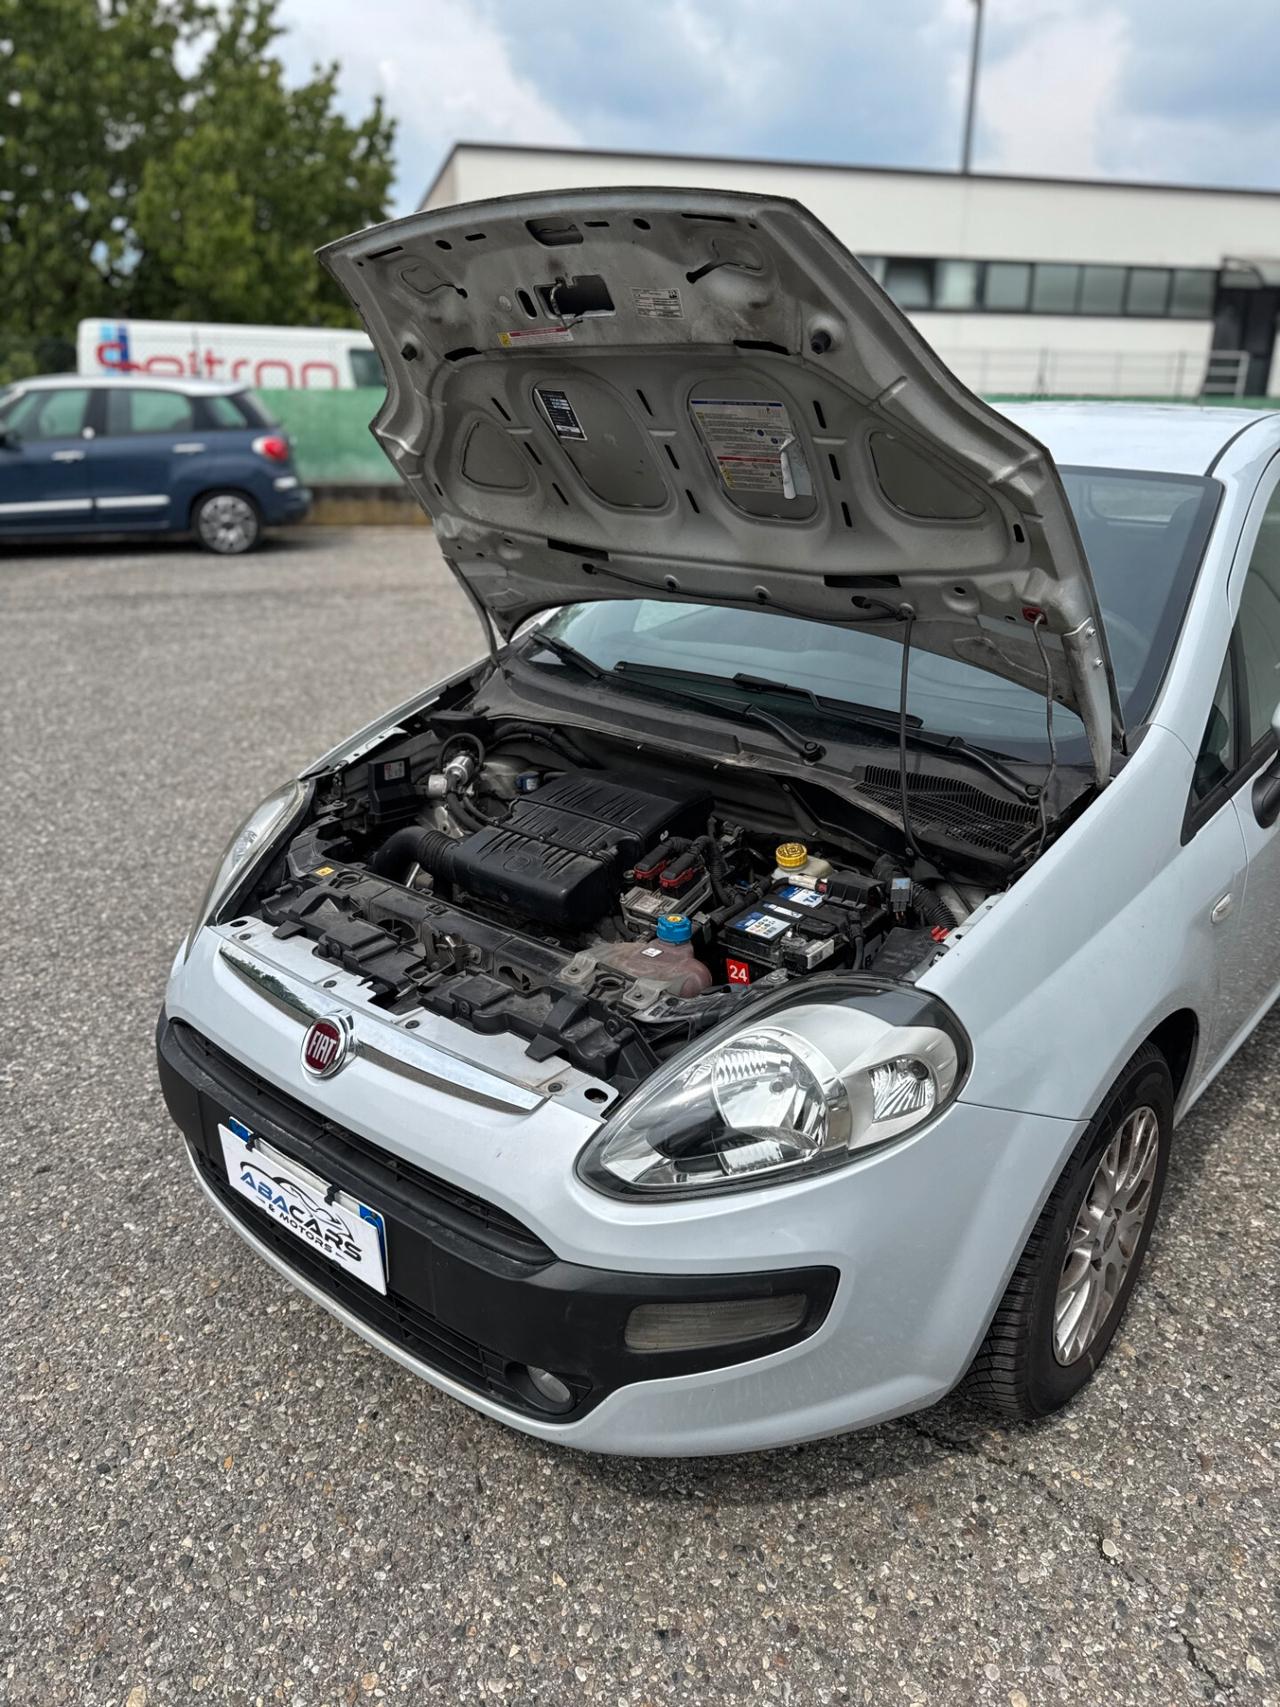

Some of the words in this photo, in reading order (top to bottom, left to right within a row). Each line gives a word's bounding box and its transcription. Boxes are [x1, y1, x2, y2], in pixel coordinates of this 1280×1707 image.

[729, 965, 748, 982] 24
[308, 1030, 337, 1065] FIAT
[240, 1171, 362, 1262] ABACARS
[268, 1205, 276, 1213] &
[279, 1213, 333, 1252] MOTORS
